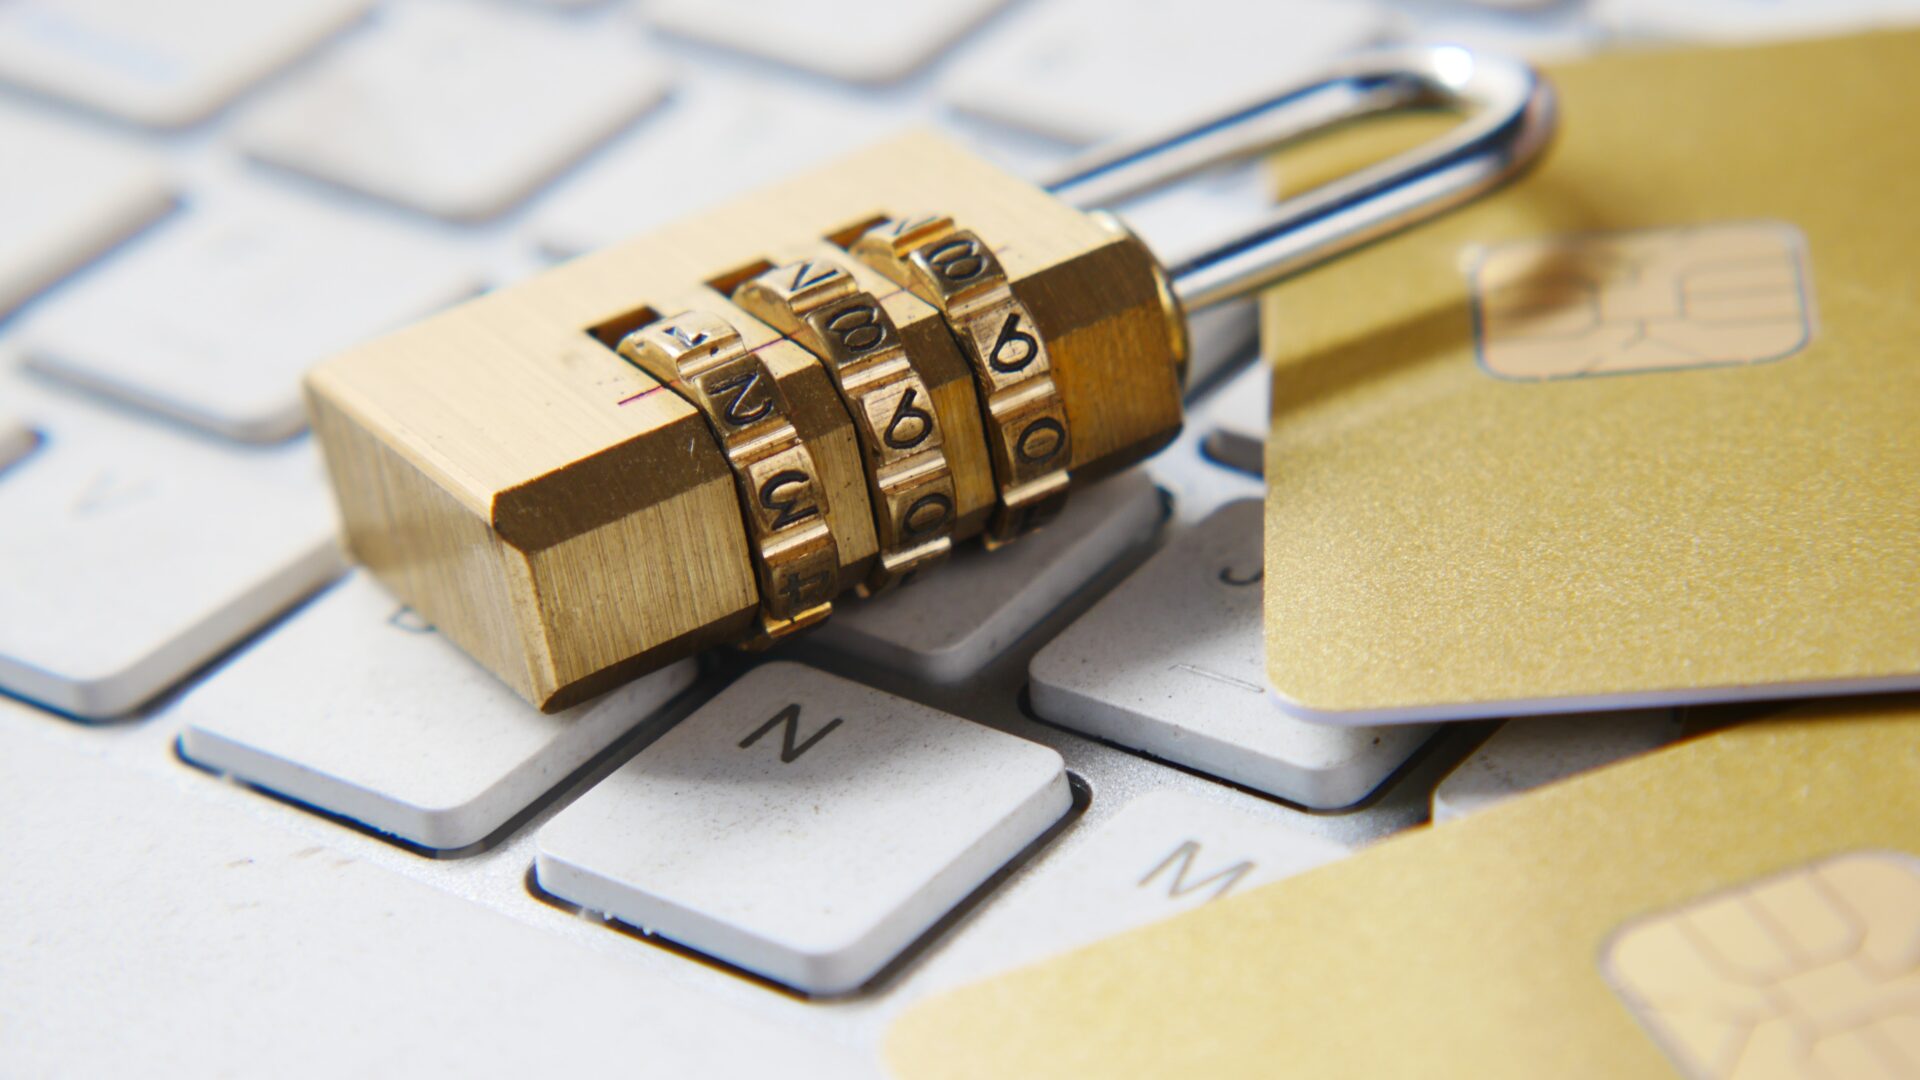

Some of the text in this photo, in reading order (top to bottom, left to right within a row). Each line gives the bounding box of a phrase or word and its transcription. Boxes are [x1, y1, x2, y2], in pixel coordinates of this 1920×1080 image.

[826, 304, 886, 351] 8
[708, 372, 774, 426] 2
[738, 703, 843, 764] N
[1136, 840, 1257, 902] M
